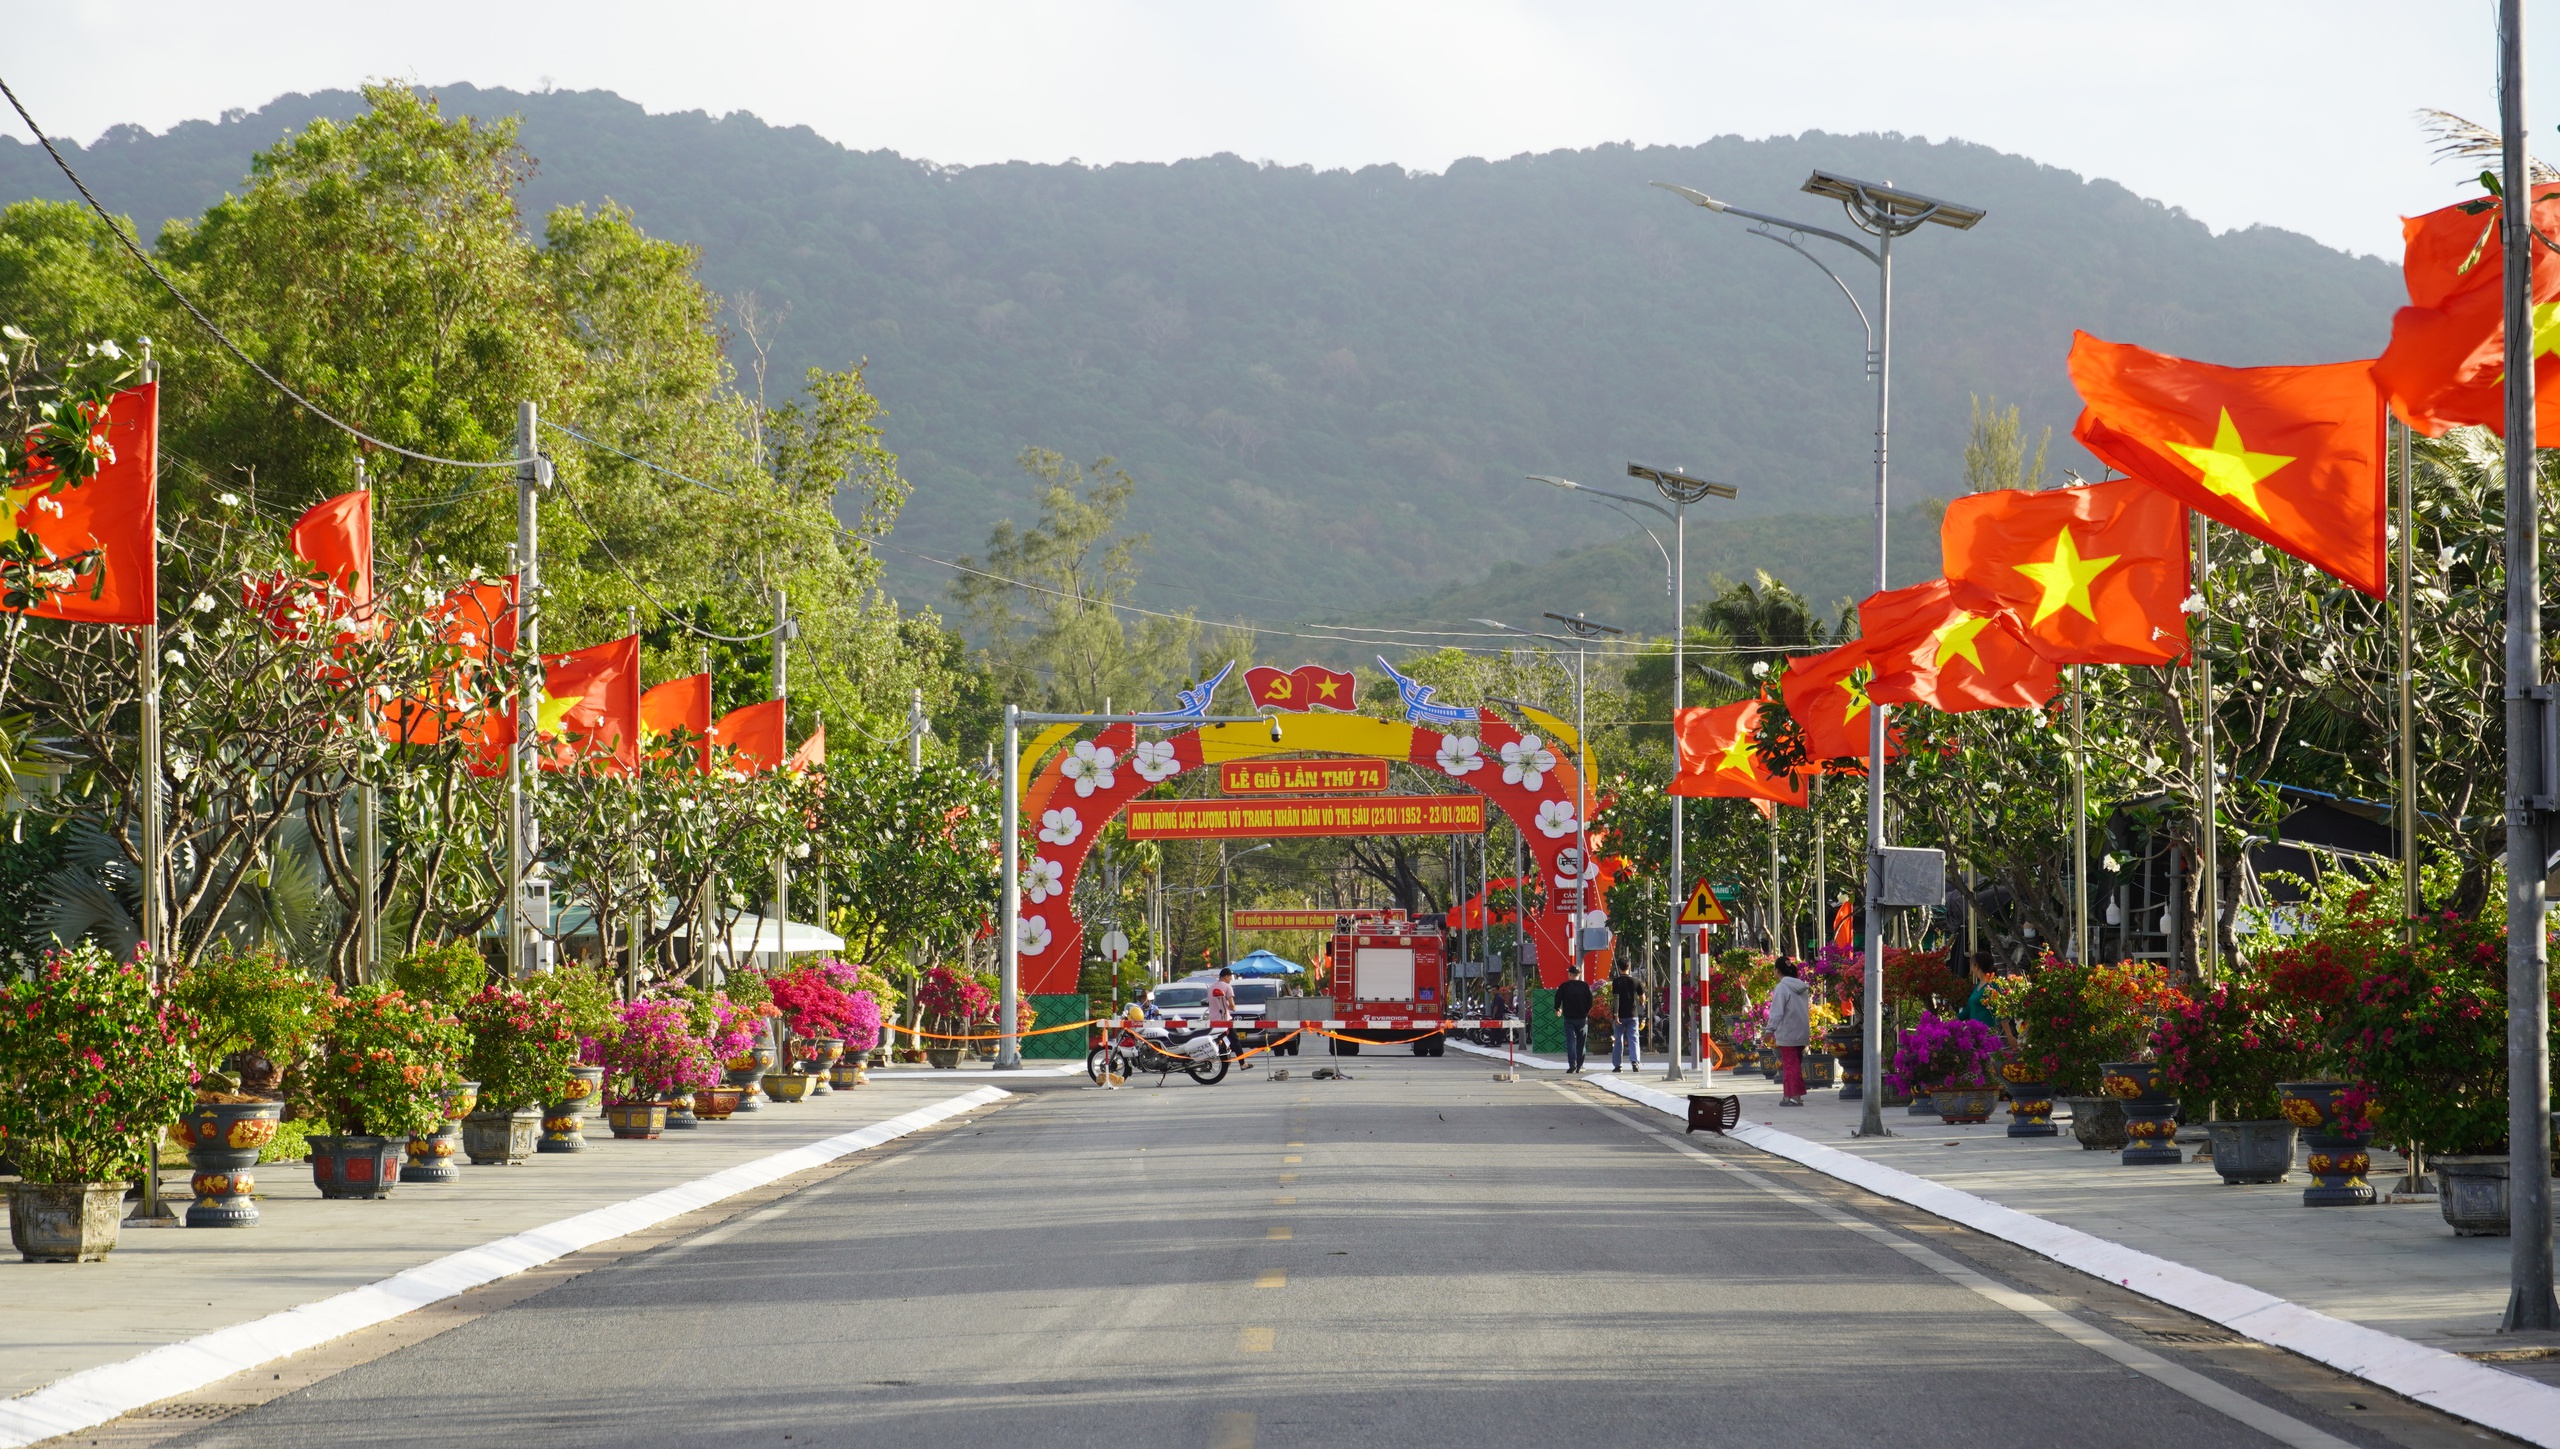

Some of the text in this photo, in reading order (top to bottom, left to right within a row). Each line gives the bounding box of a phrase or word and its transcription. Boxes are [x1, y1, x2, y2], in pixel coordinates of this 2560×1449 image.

[1230, 765, 1379, 789] LỄ GIỖ LẦN THỨ 74
[1132, 812, 1151, 830] ANH
[1152, 808, 1178, 830] HÙNG
[1179, 811, 1196, 832] LỰC
[1197, 811, 1227, 832] LƯỢNG
[1242, 809, 1273, 828] TRANG
[1274, 806, 1300, 827] NHÂN
[1301, 805, 1320, 827] DÂN
[1335, 807, 1350, 829] THỊ
[1352, 804, 1369, 826] SÁU
[1371, 806, 1422, 828] (23/01/1952
[1429, 805, 1479, 826] 23/01/2026)
[1245, 913, 1262, 926] QUỐC
[1284, 916, 1295, 925] GHI
[1309, 914, 1325, 925] CÔNG
